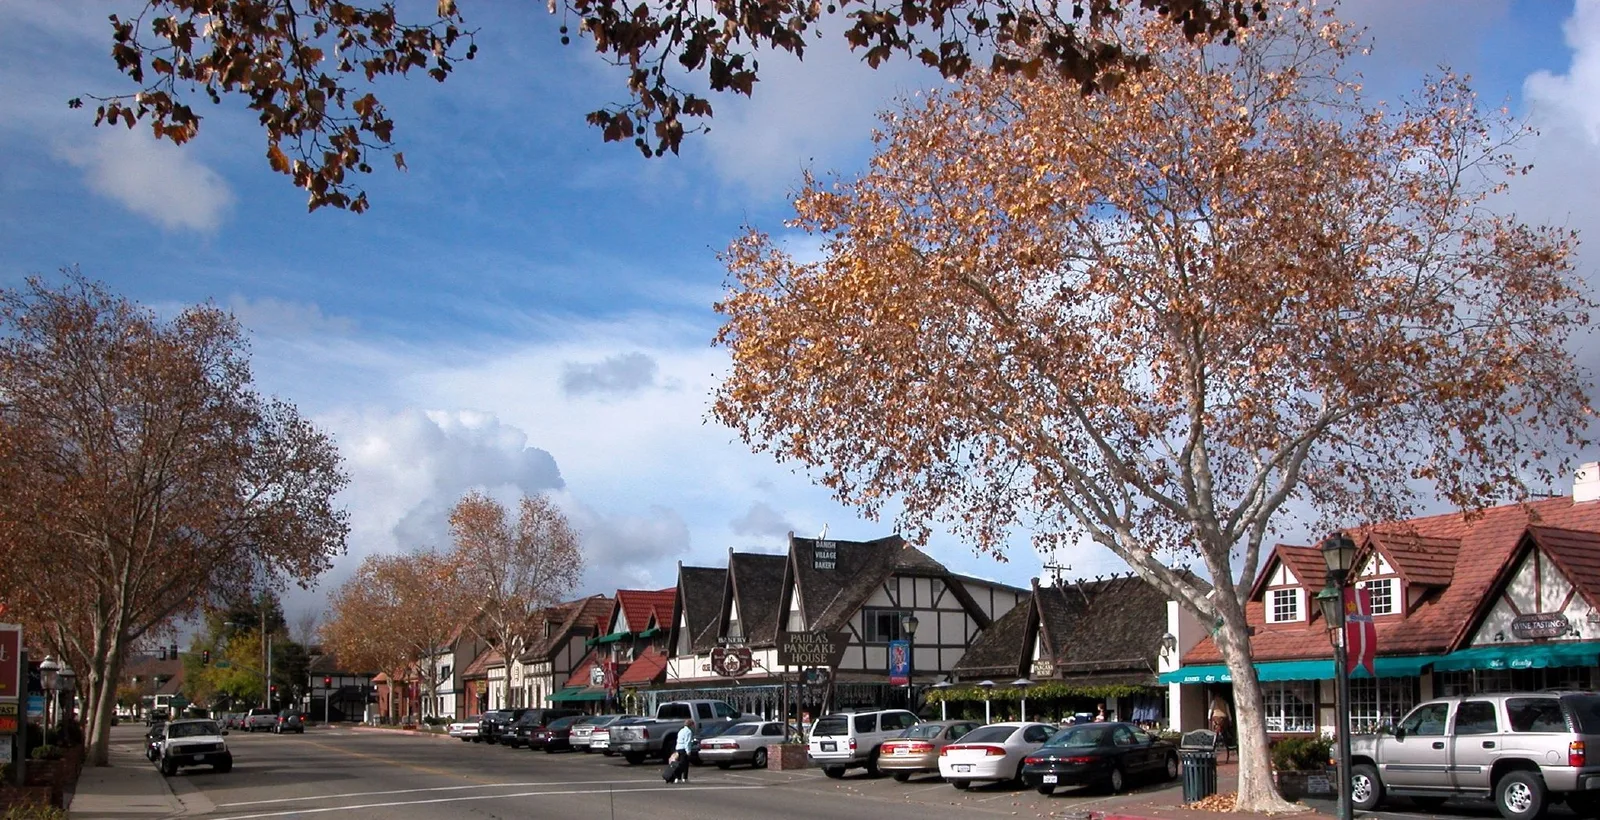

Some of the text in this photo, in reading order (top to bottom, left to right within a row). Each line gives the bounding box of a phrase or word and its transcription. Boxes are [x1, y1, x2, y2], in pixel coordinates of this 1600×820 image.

[815, 541, 836, 549] DANISH
[815, 551, 837, 559] VILLAGE
[814, 561, 836, 569] BAKERY
[1513, 620, 1565, 630] WINE TASTINGS
[783, 643, 836, 654] PANCAKE
[792, 653, 828, 663] HOUSE
